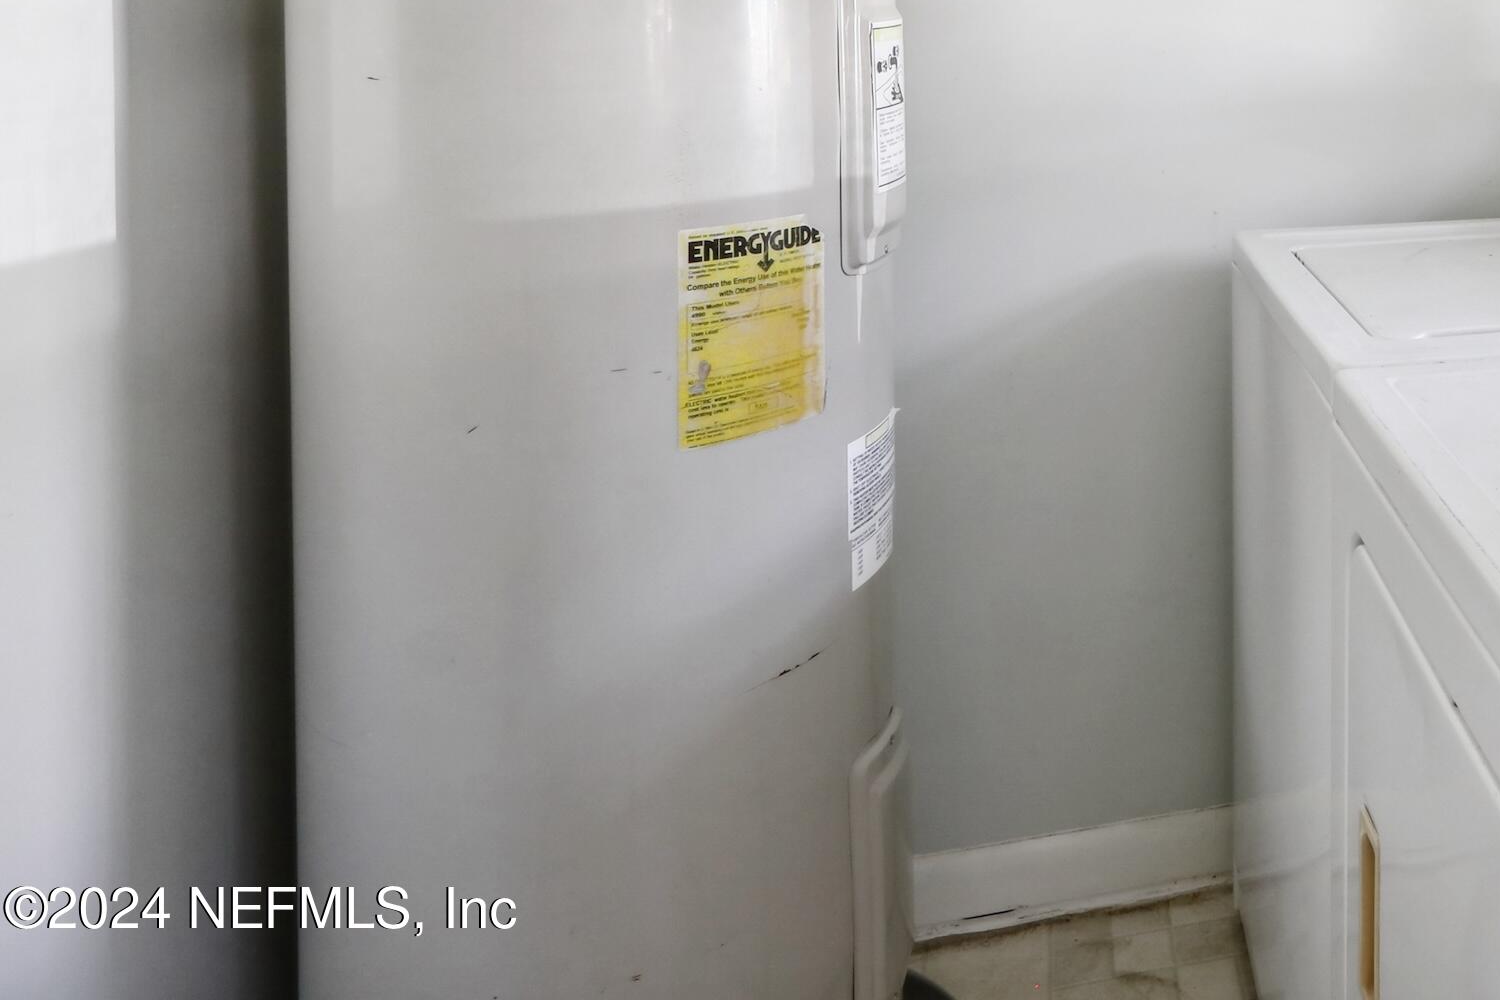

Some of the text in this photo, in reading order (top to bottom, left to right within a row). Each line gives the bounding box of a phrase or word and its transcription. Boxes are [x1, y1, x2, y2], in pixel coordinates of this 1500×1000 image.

[688, 225, 821, 264] ENERGYGUIDE
[687, 282, 719, 292] Compare
[721, 279, 732, 287] the
[733, 276, 756, 286] Energy
[771, 271, 778, 279] of
[719, 289, 734, 297] with
[735, 286, 757, 295] Others
